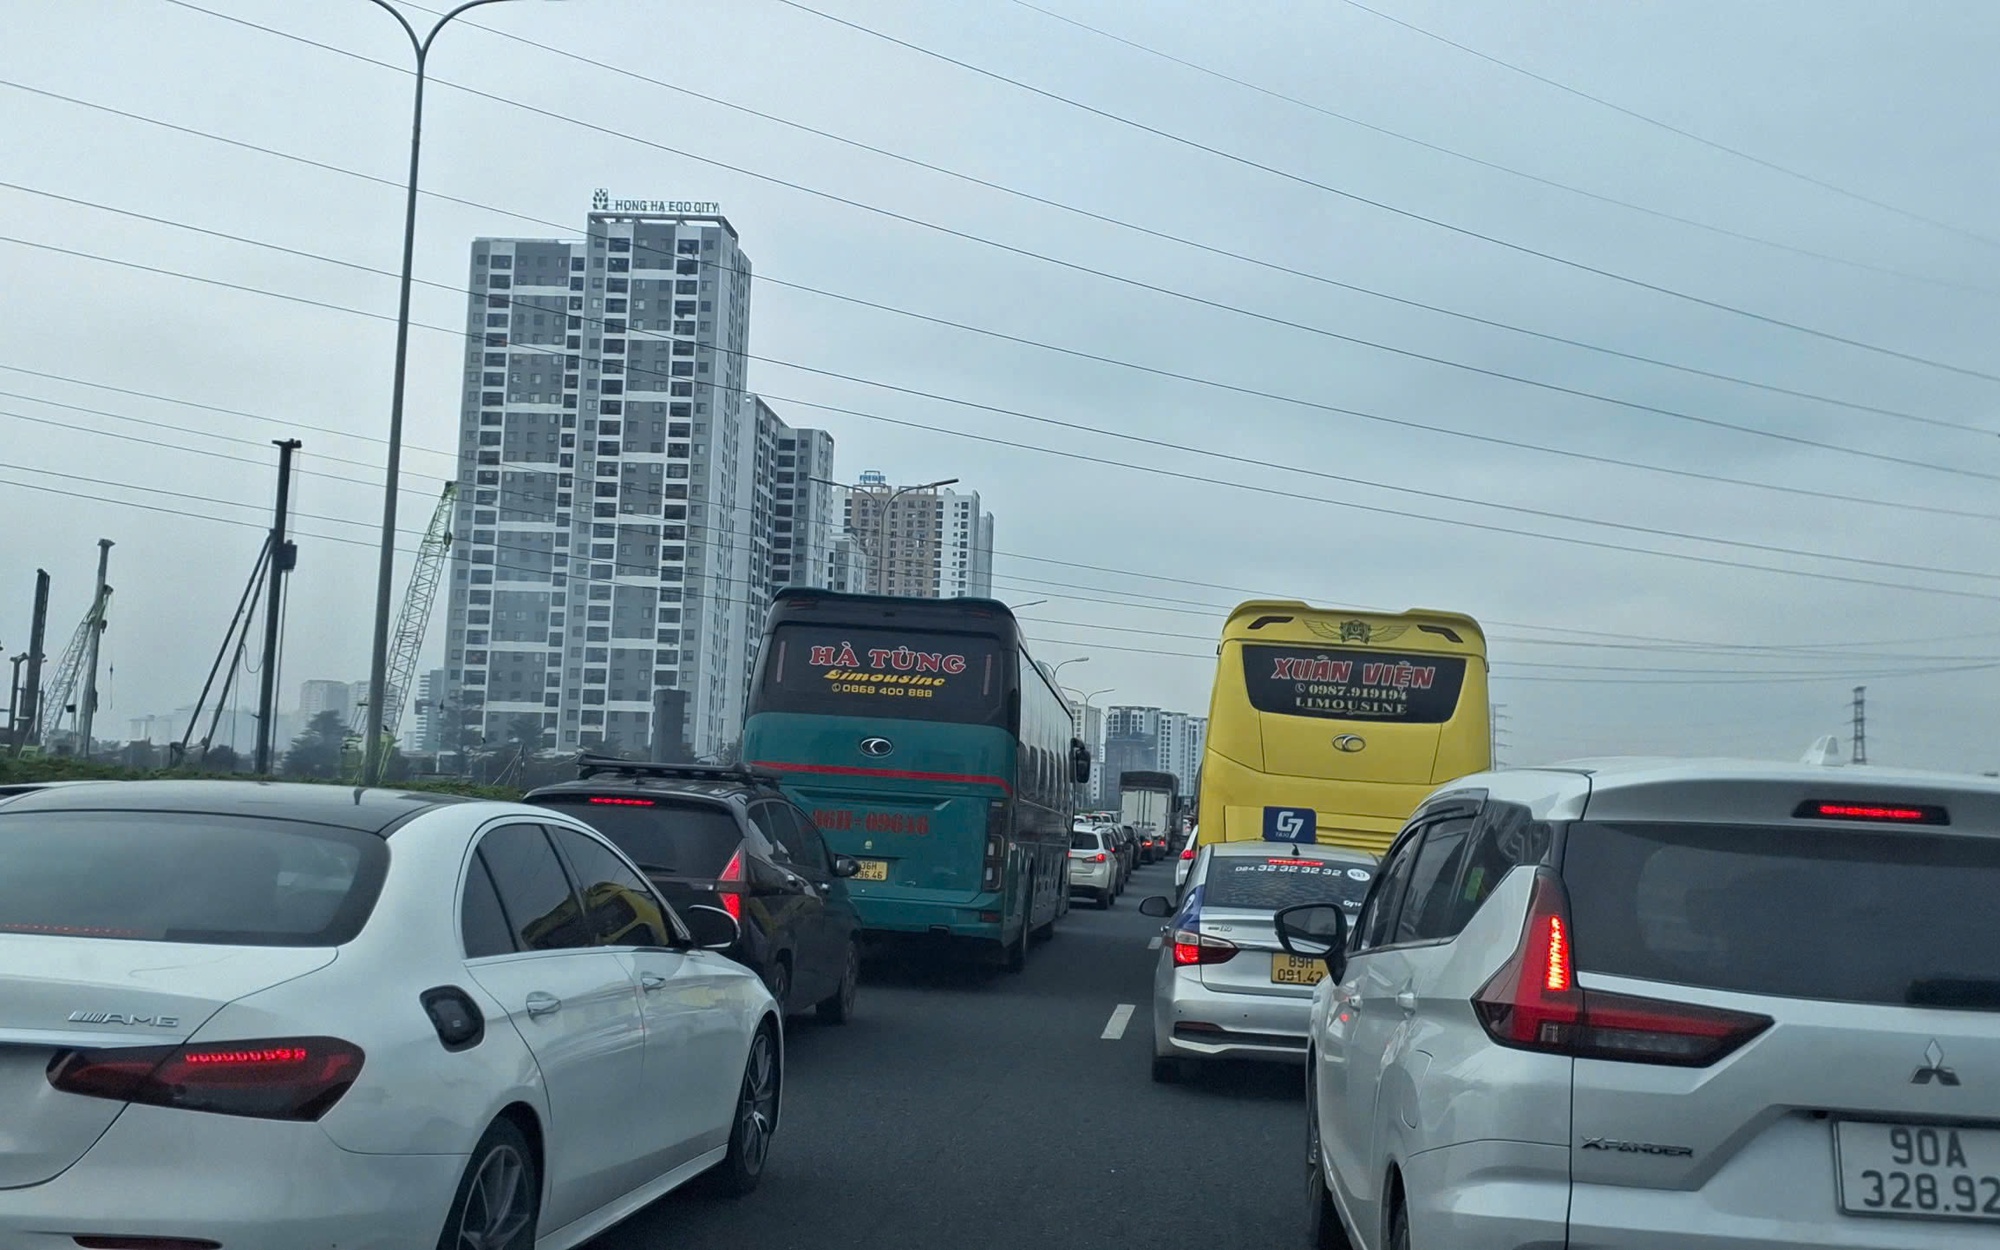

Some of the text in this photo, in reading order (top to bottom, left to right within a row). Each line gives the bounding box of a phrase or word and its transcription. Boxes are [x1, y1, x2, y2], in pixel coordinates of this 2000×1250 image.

[615, 199, 647, 211] HONG
[694, 202, 719, 213] CITY
[809, 641, 966, 674] HÀ TÙNG
[1271, 655, 1353, 683] XUÂN
[842, 683, 933, 697] 0868 400 888
[1296, 697, 1408, 714] LIMOUSINE
[1277, 811, 1304, 838] G7
[1279, 865, 1299, 873] 32
[1301, 866, 1320, 874] 32
[1322, 868, 1342, 876] 32
[103, 1012, 179, 1028] AMG
[1581, 1137, 1693, 1158] XPANDER
[1890, 1126, 1968, 1168] 90A
[1861, 1169, 2000, 1215] 328.92
